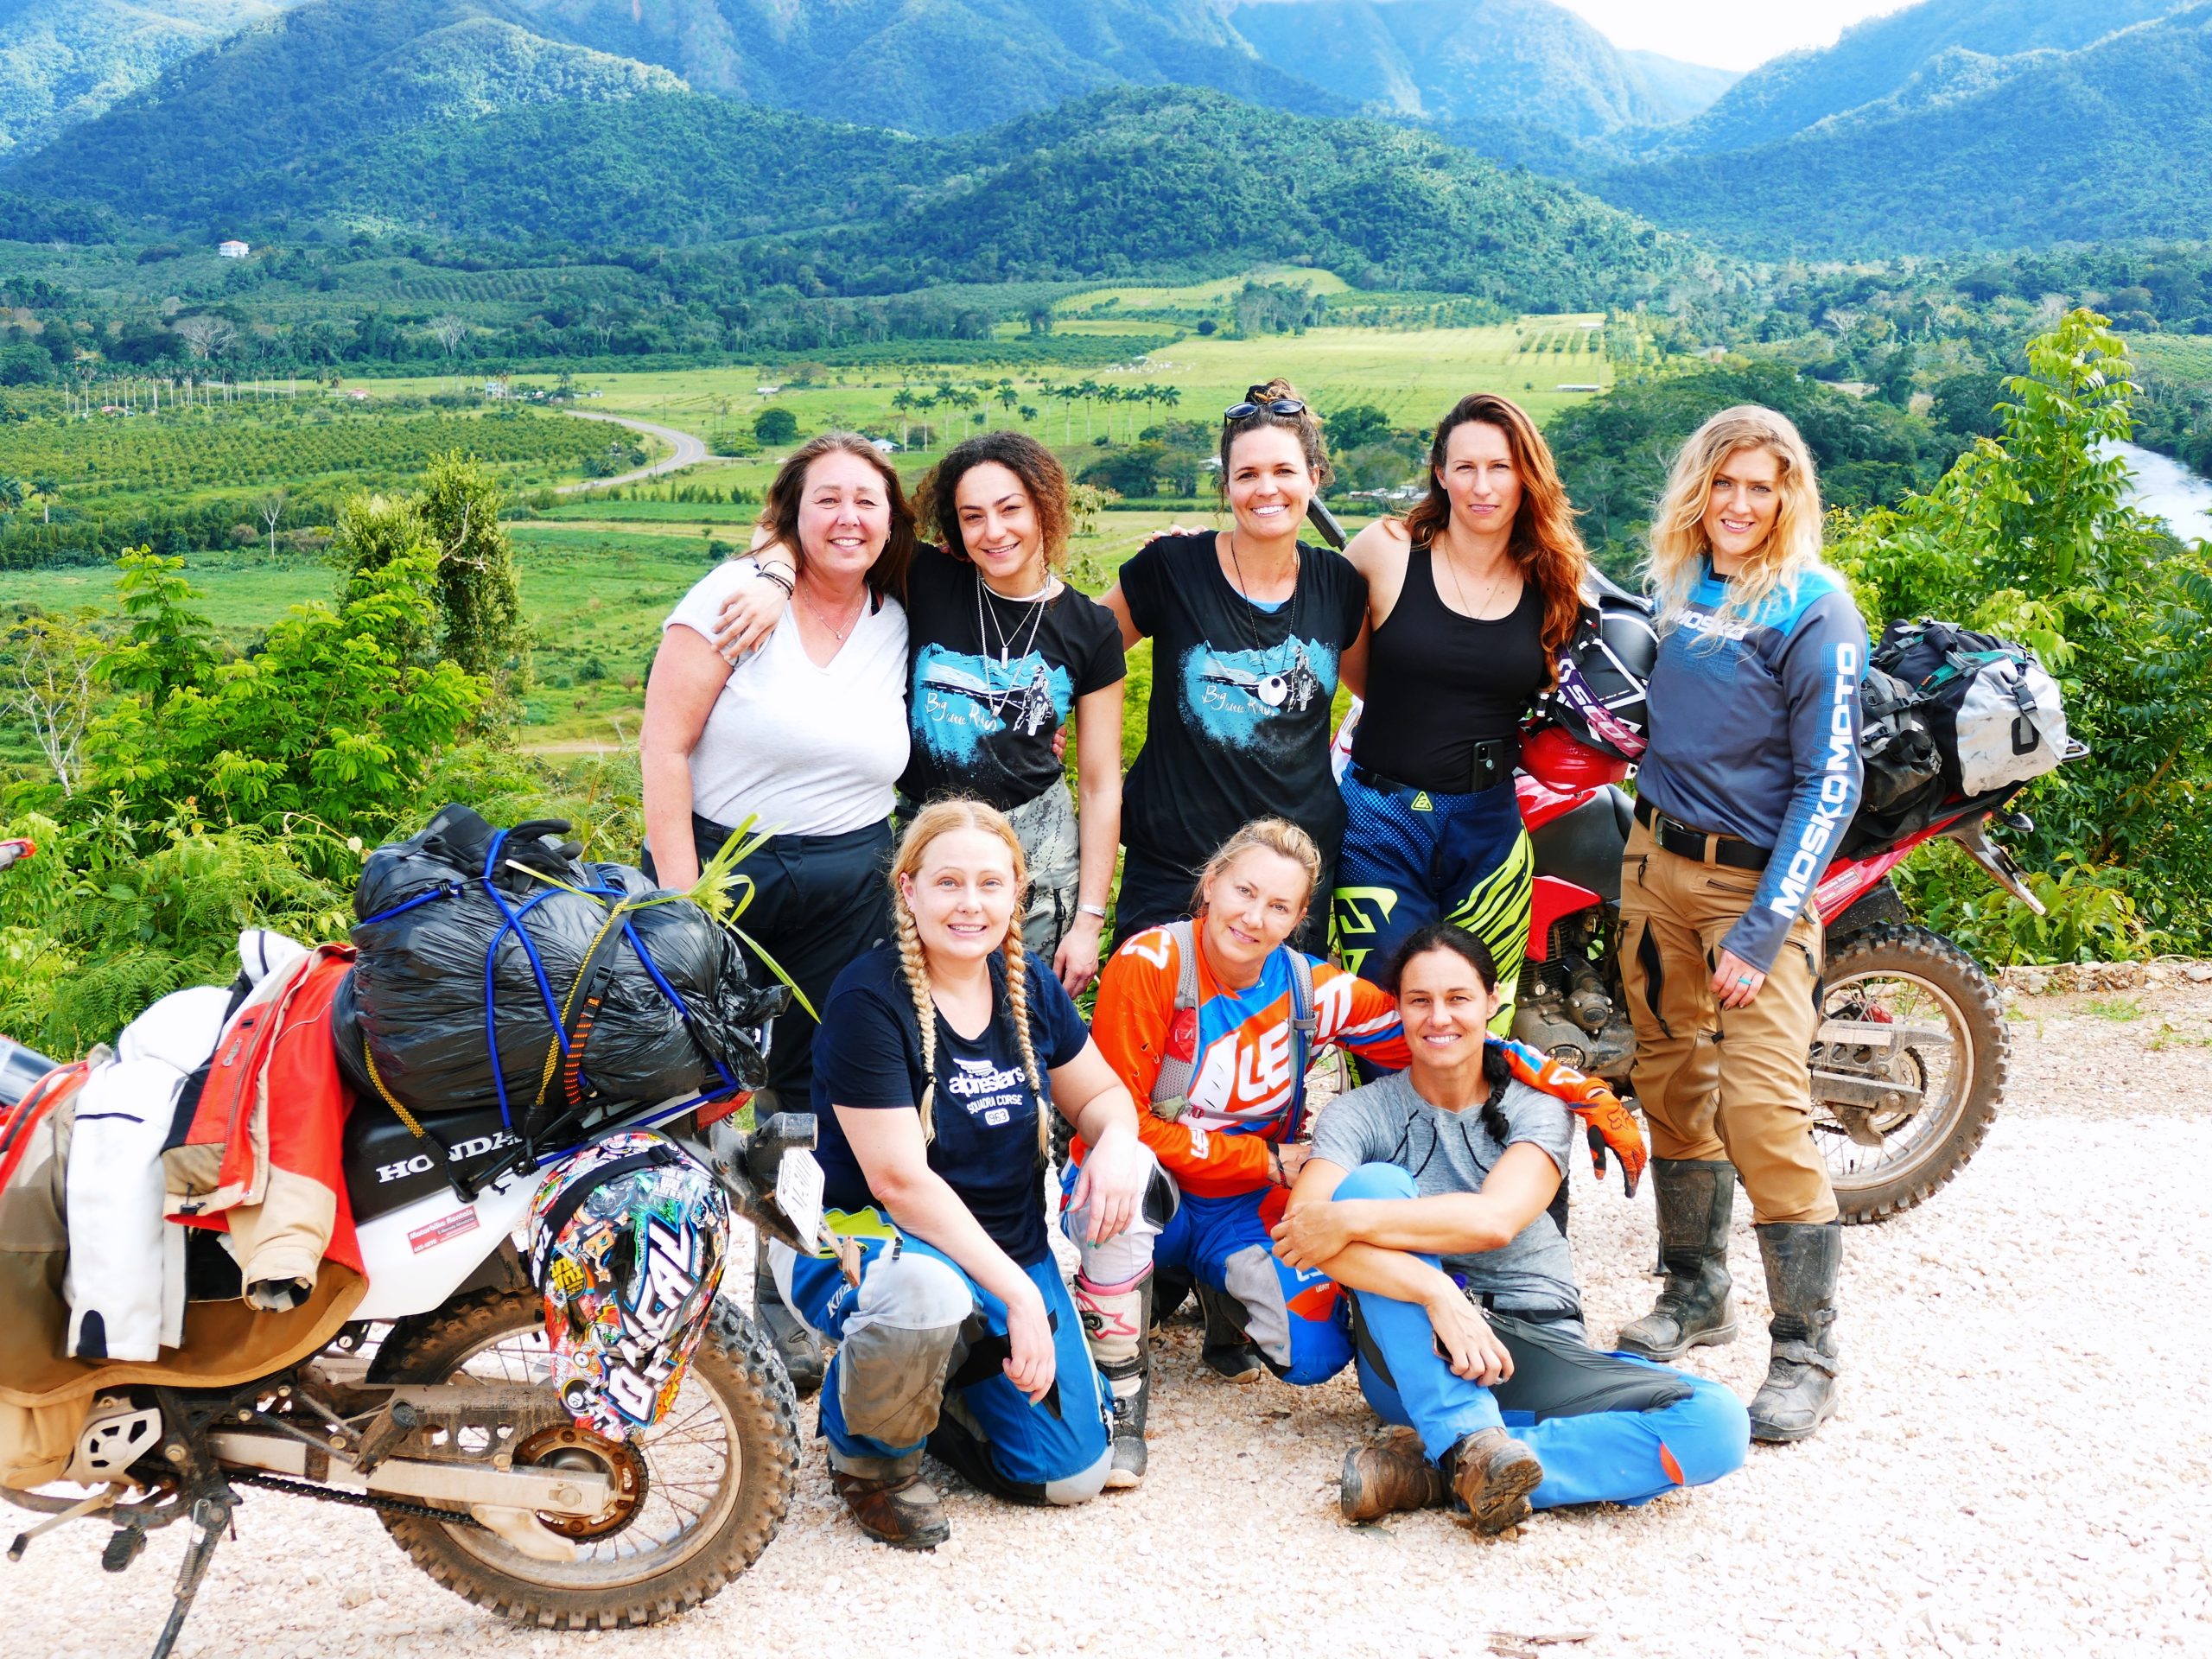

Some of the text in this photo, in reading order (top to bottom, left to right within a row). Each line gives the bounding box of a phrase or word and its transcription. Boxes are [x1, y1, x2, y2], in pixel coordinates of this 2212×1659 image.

[925, 692, 948, 721] Big
[1201, 685, 1227, 710] Big
[948, 1066, 1026, 1097] alpinestars
[966, 1094, 1023, 1115] SQUADRA CORSE
[987, 1110, 1007, 1123] 1963
[375, 1131, 523, 1183] HONDA
